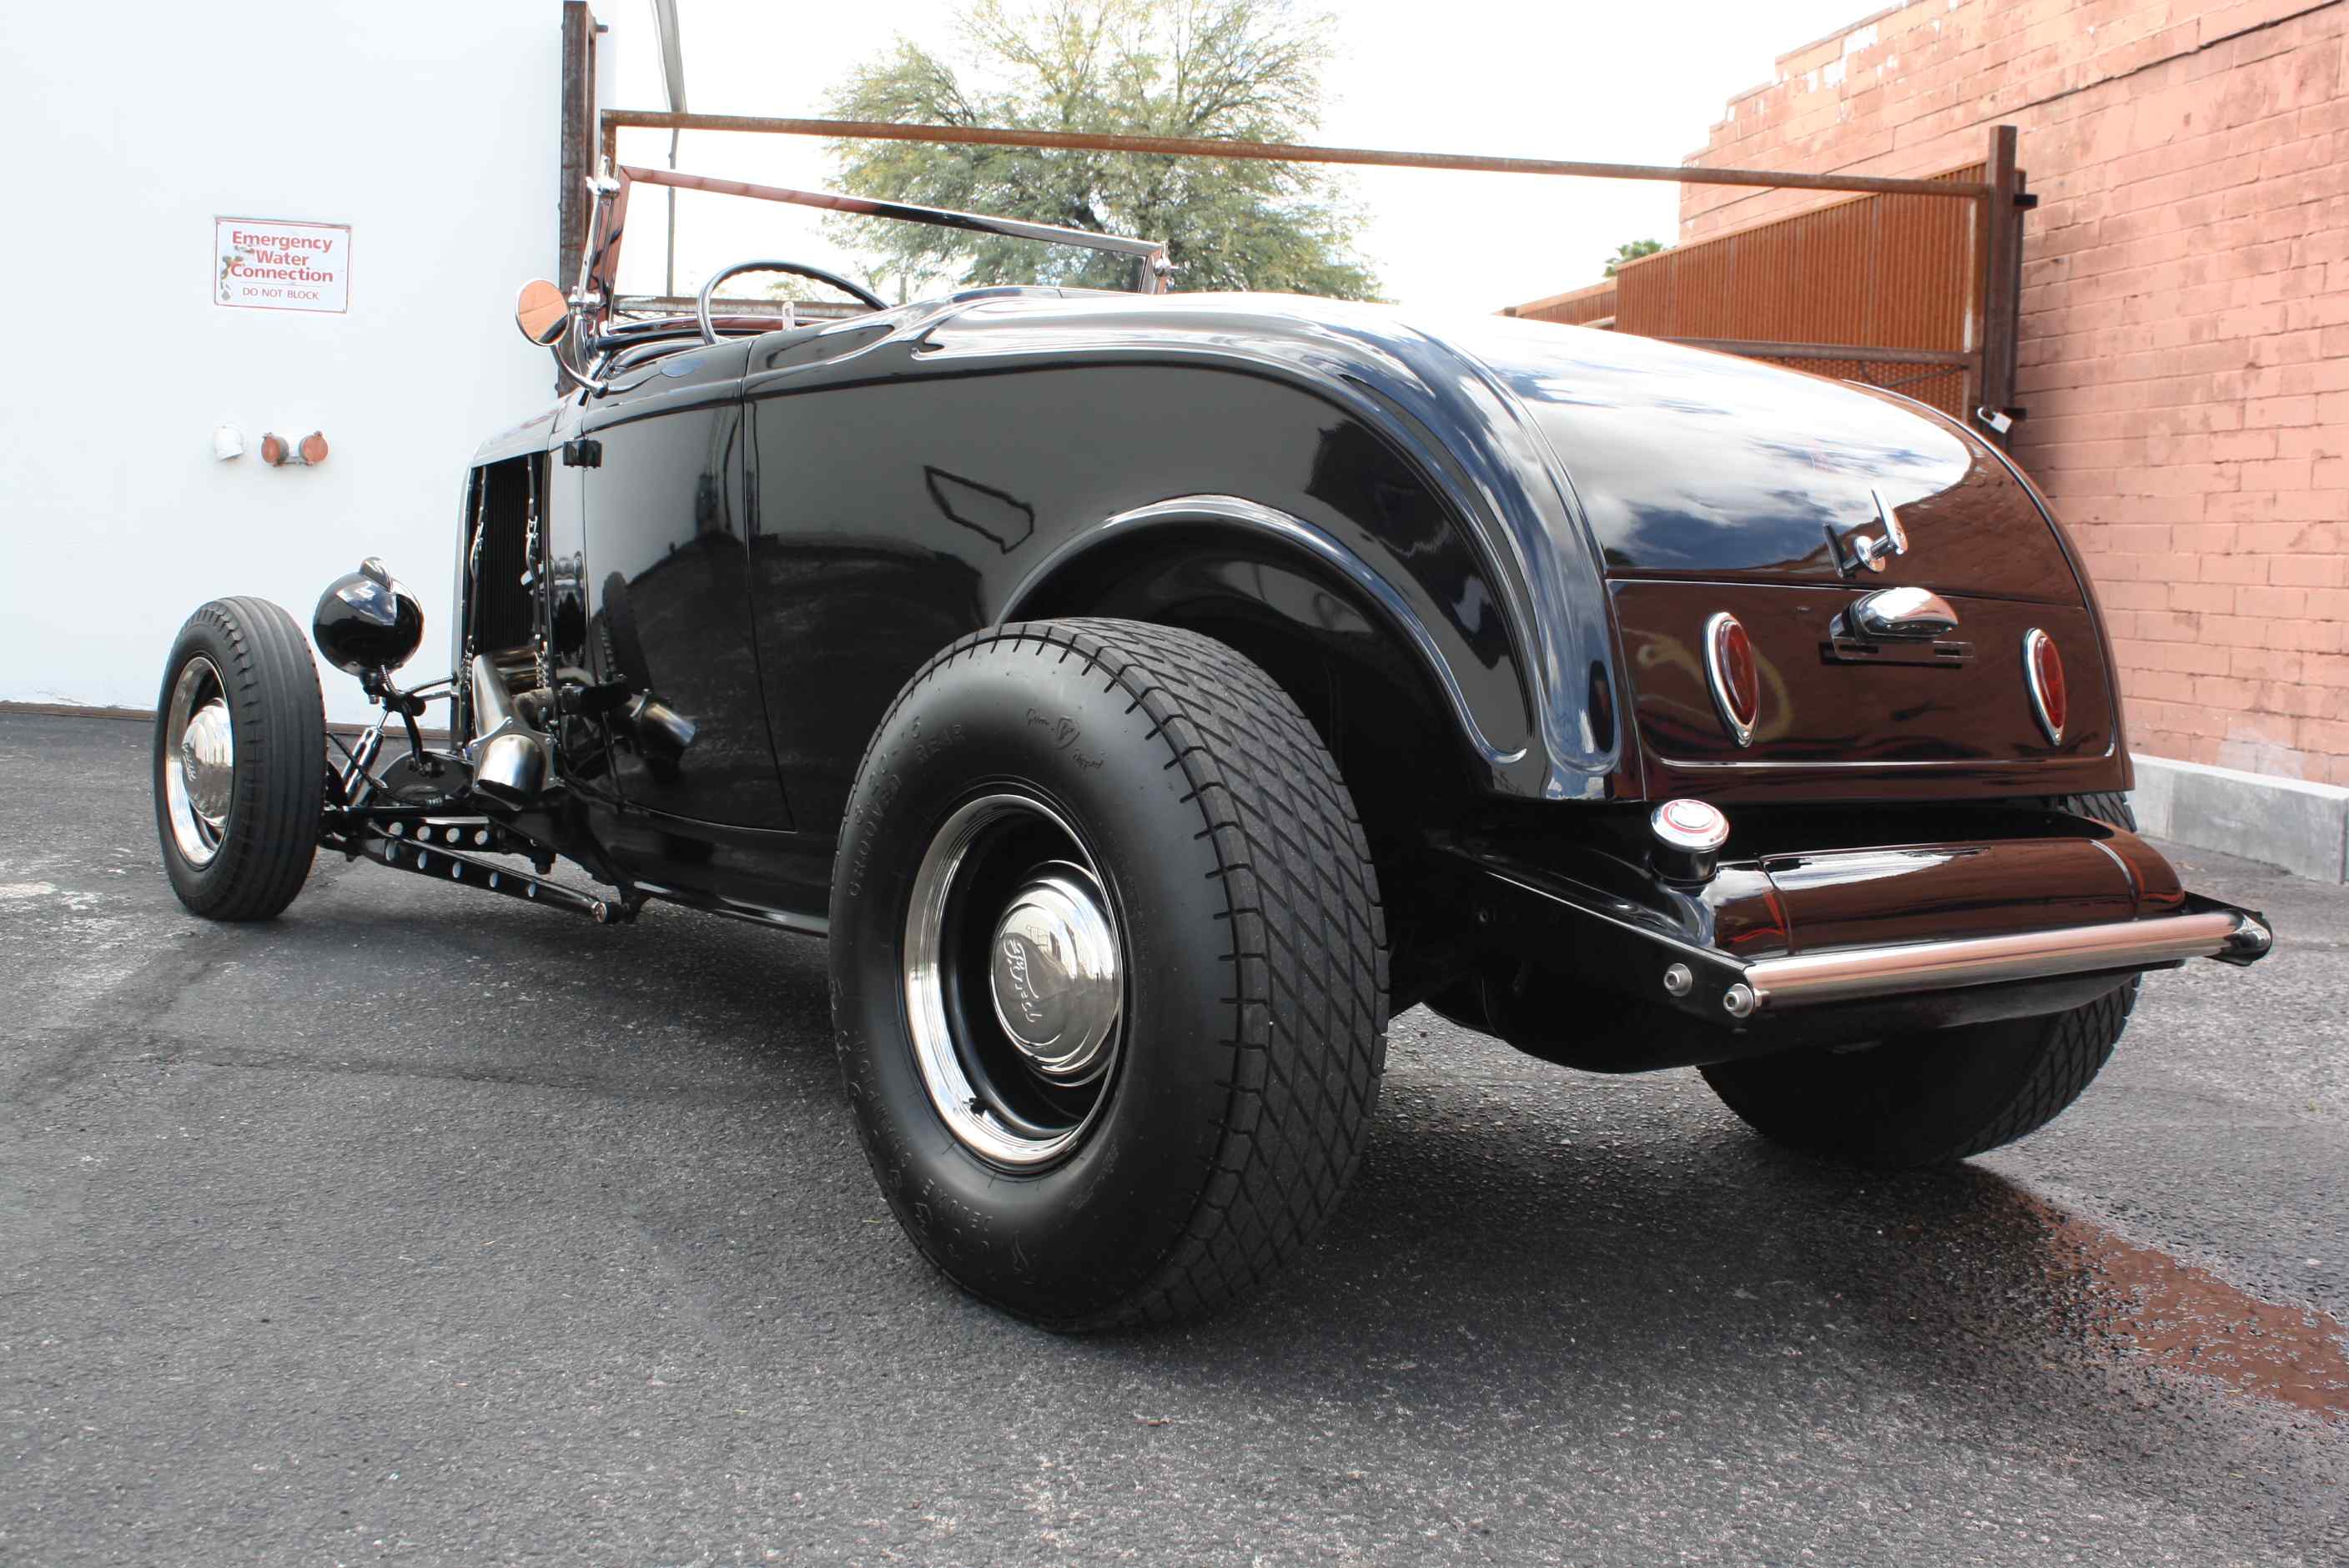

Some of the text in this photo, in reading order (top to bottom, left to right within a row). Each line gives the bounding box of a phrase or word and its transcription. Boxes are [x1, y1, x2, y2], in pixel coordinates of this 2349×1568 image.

[232, 230, 333, 254] Emergency
[255, 249, 309, 266] Water
[230, 263, 334, 283] Connection
[243, 287, 320, 301] DO NOT BLOCK
